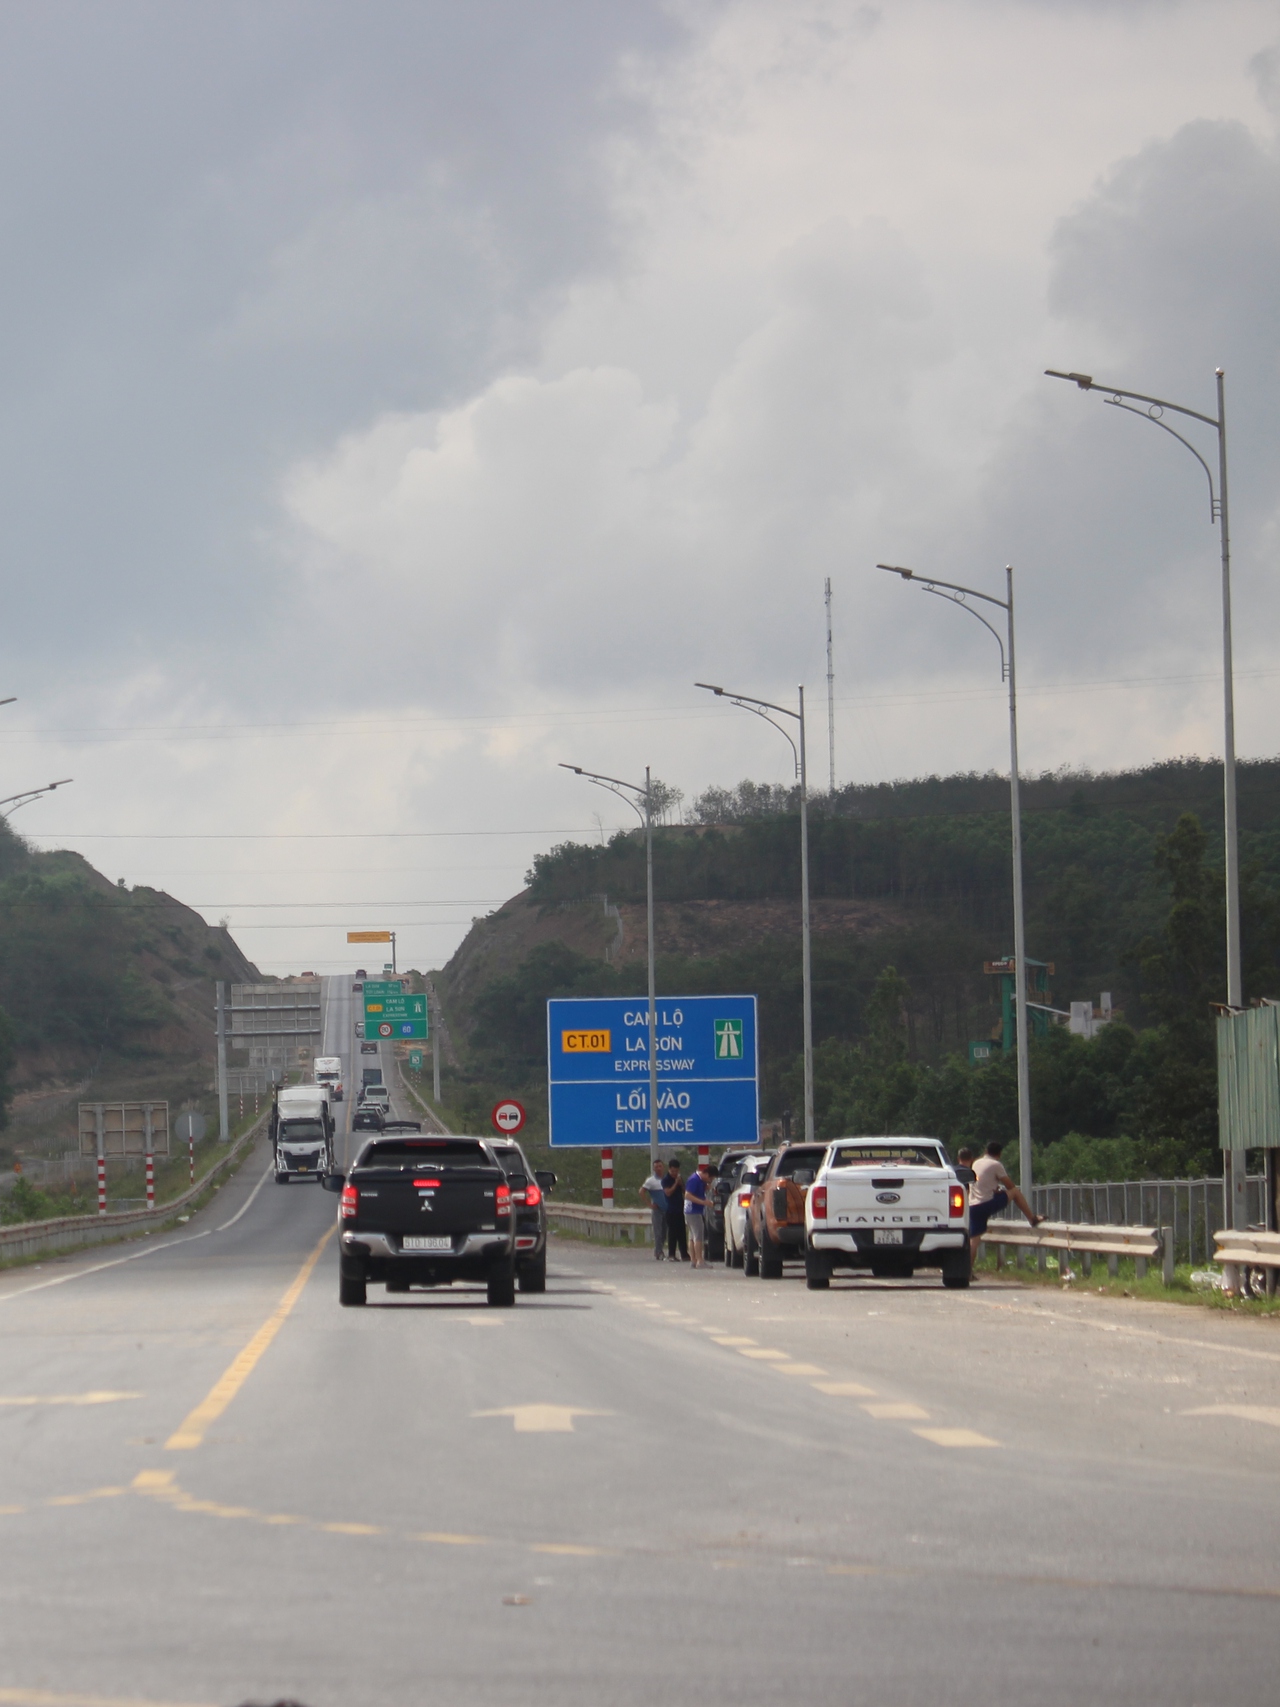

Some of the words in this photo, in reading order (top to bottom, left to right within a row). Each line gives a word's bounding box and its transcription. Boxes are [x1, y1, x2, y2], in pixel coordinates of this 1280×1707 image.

[624, 1011, 658, 1026] CAM
[662, 1008, 684, 1029] LỘ
[402, 1025, 411, 1034] 60
[567, 1034, 605, 1048] CT.01
[625, 1037, 646, 1052] LA
[616, 1087, 647, 1111] LỐI
[655, 1087, 691, 1109] VÀO
[615, 1118, 694, 1134] ENTRANCE
